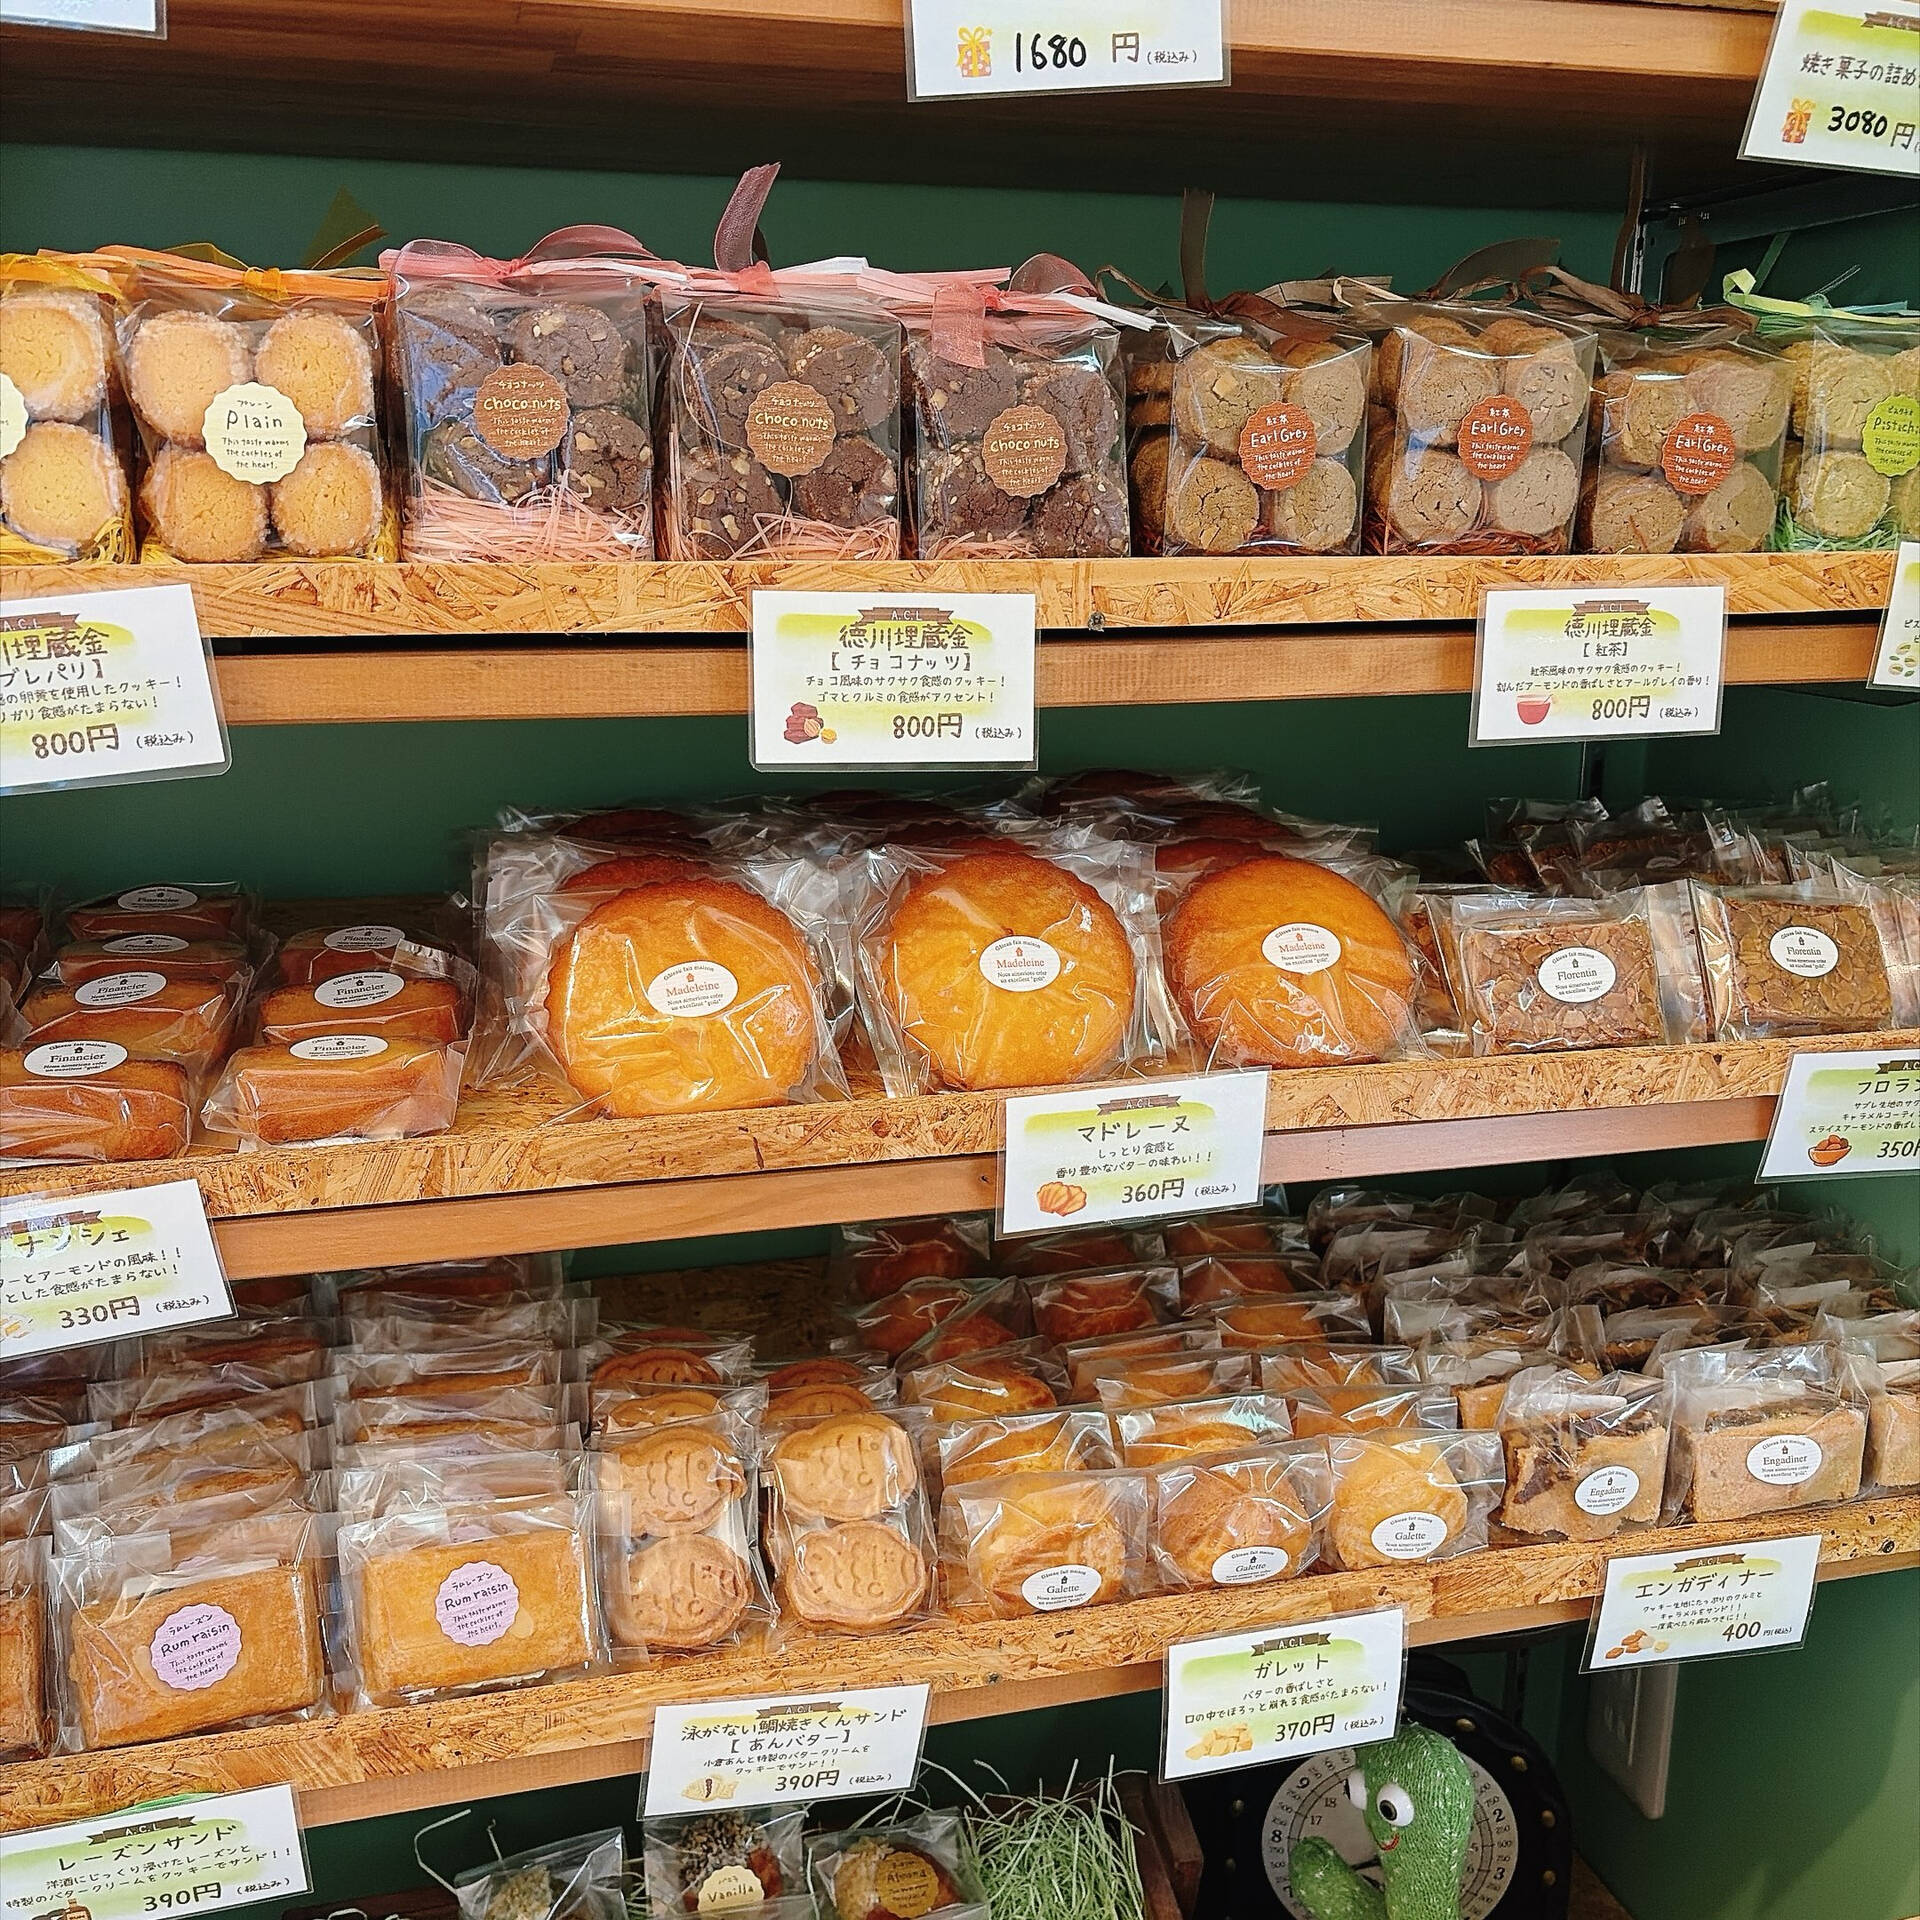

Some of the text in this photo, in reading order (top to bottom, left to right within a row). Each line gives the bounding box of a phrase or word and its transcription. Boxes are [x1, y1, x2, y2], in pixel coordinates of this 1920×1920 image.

[1015, 32, 1198, 72] 1680 円 （税込み）
[1800, 52, 1920, 88] 焼き菓子の詰め
[1827, 106, 1916, 150] 3080 円
[484, 397, 561, 410] Choco nuts
[226, 410, 282, 430] Plain
[755, 412, 829, 430] Choco nuts
[1471, 420, 1526, 437] Earl Grey
[990, 437, 1060, 452] Choco nuts
[1251, 428, 1308, 448] Earl Grey
[1676, 435, 1729, 455] Earl Grey
[839, 624, 974, 651] 徳川埋蔵金
[1564, 616, 1657, 640] 徳川埋蔵金
[1582, 642, 1628, 658] 【紅茶】
[831, 652, 971, 672] 【チョコナッツ】
[806, 674, 1006, 688] チョコ風味のサクサク食感のクッキー！
[817, 690, 994, 704] ゴマとクルミの食感がアクセント！
[1592, 694, 1699, 722] 800円 （税込み）
[892, 712, 1022, 740] 800円 （税込み）
[32, 723, 194, 759] 800円 （税込み）
[1278, 942, 1326, 953] Madeleine
[1786, 946, 1822, 956] Florentin
[996, 958, 1045, 969] Madeleine
[1557, 968, 1598, 981] Florentin
[96, 982, 148, 994] Financier
[336, 983, 386, 996] Financier
[666, 982, 720, 998] Madeleine
[49, 1052, 106, 1064] Financier
[1842, 1110, 1920, 1122] キャラメルコーティ
[1078, 1114, 1190, 1143] マドレーヌ
[1809, 1121, 1920, 1134] スライスアーモンドの香ばし
[1098, 1140, 1175, 1159] しっとり食感と
[1055, 1151, 1212, 1179] 香り豊かなバターの味わい！！
[1121, 1178, 1236, 1204] 360円 （税込み）
[6, 1264, 179, 1304] とした食感がたまらない！
[58, 1295, 210, 1330] 330円 （税込み）
[1763, 1456, 1808, 1466] Engadiner
[1590, 1486, 1626, 1497] Engadiner
[1395, 1532, 1426, 1540] Galette
[1236, 1563, 1266, 1572] Galette
[1046, 1585, 1080, 1594] Galette
[1635, 1568, 1774, 1599] エンガディナー
[444, 1583, 509, 1611] Rum raisin
[160, 1624, 230, 1658] Rum raisin
[1722, 1621, 1762, 1642] 400
[1254, 1652, 1329, 1679] ガレット
[1243, 1678, 1334, 1700] バターの香ばしさと
[1184, 1681, 1388, 1725] 口の中でほろっと崩れる食感がたまらない！
[681, 1708, 908, 1742] 泳がない鯛焼きくんサンド
[1274, 1714, 1384, 1742] 370円 （税込み）
[730, 1729, 851, 1754] 【あんバター】
[736, 1759, 836, 1775] クッキーでサンド！！
[774, 1770, 892, 1792] 390円 （税込み）
[1310, 1815, 1323, 1825] 17
[1493, 1808, 1506, 1822] 2
[1272, 1829, 1282, 1843] 8
[59, 1824, 237, 1872] レーズンサンド
[1493, 1866, 1506, 1880] 3
[144, 1877, 290, 1912] 390円 （税込み）
[707, 1883, 754, 1903] Vanilla
